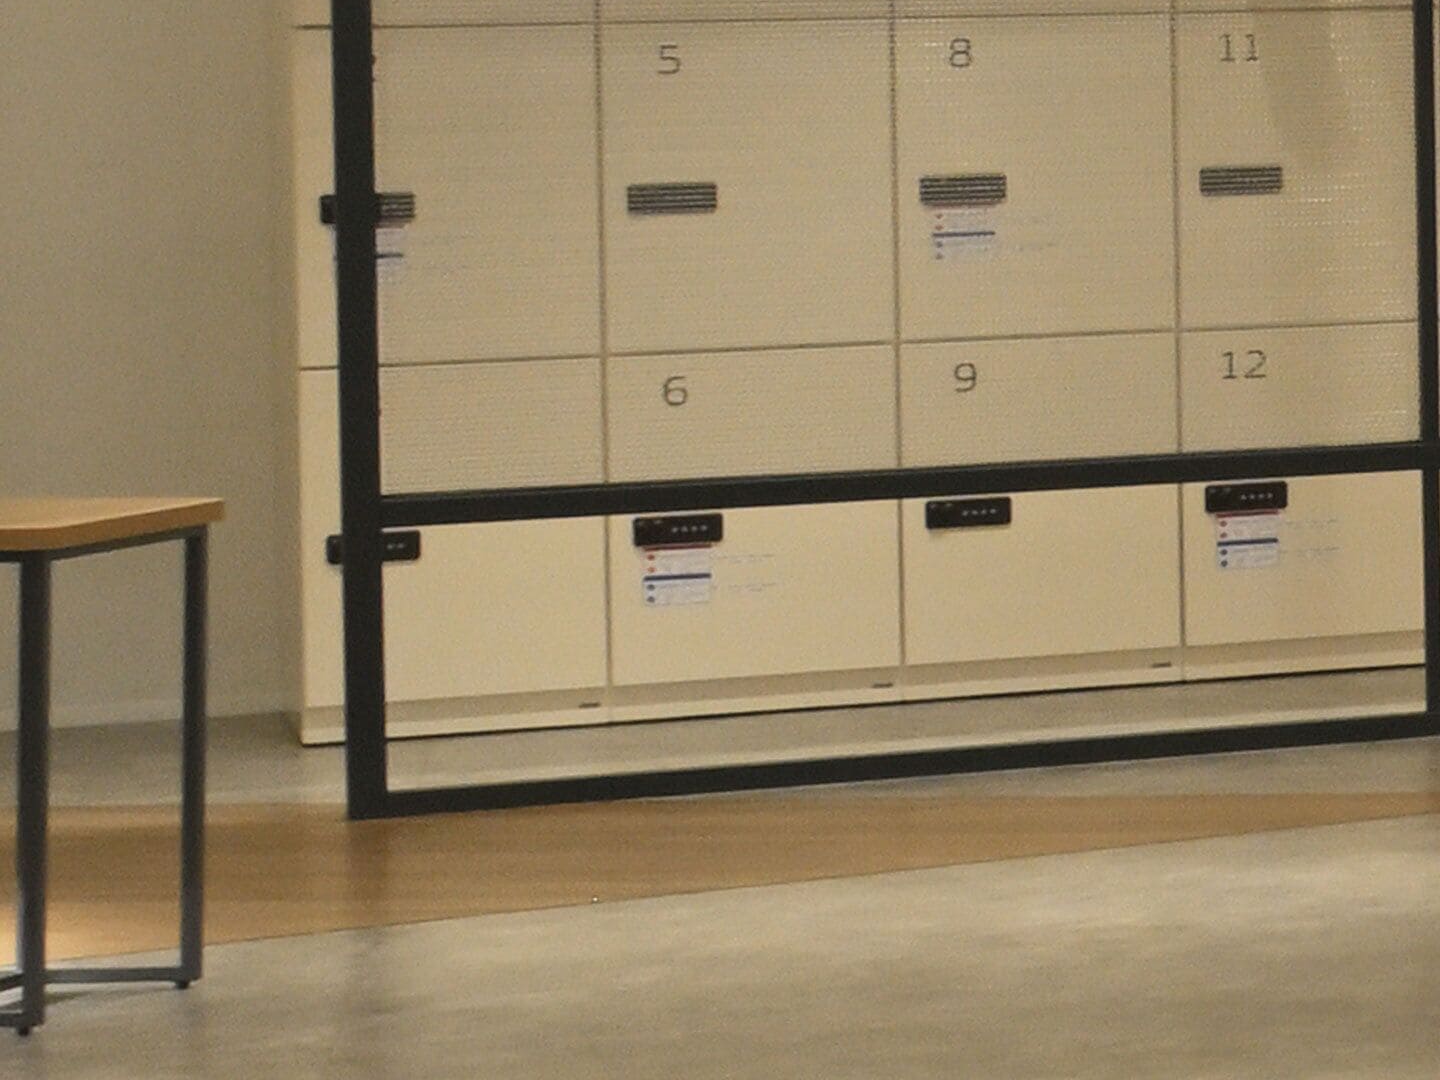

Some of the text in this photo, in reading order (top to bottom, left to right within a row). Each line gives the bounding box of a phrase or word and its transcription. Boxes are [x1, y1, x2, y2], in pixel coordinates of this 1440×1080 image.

[657, 45, 681, 74] 5
[949, 39, 972, 68] 8
[1219, 33, 1258, 62] 11
[954, 362, 977, 392] 9
[1221, 350, 1266, 380] 12
[662, 375, 688, 406] 6
